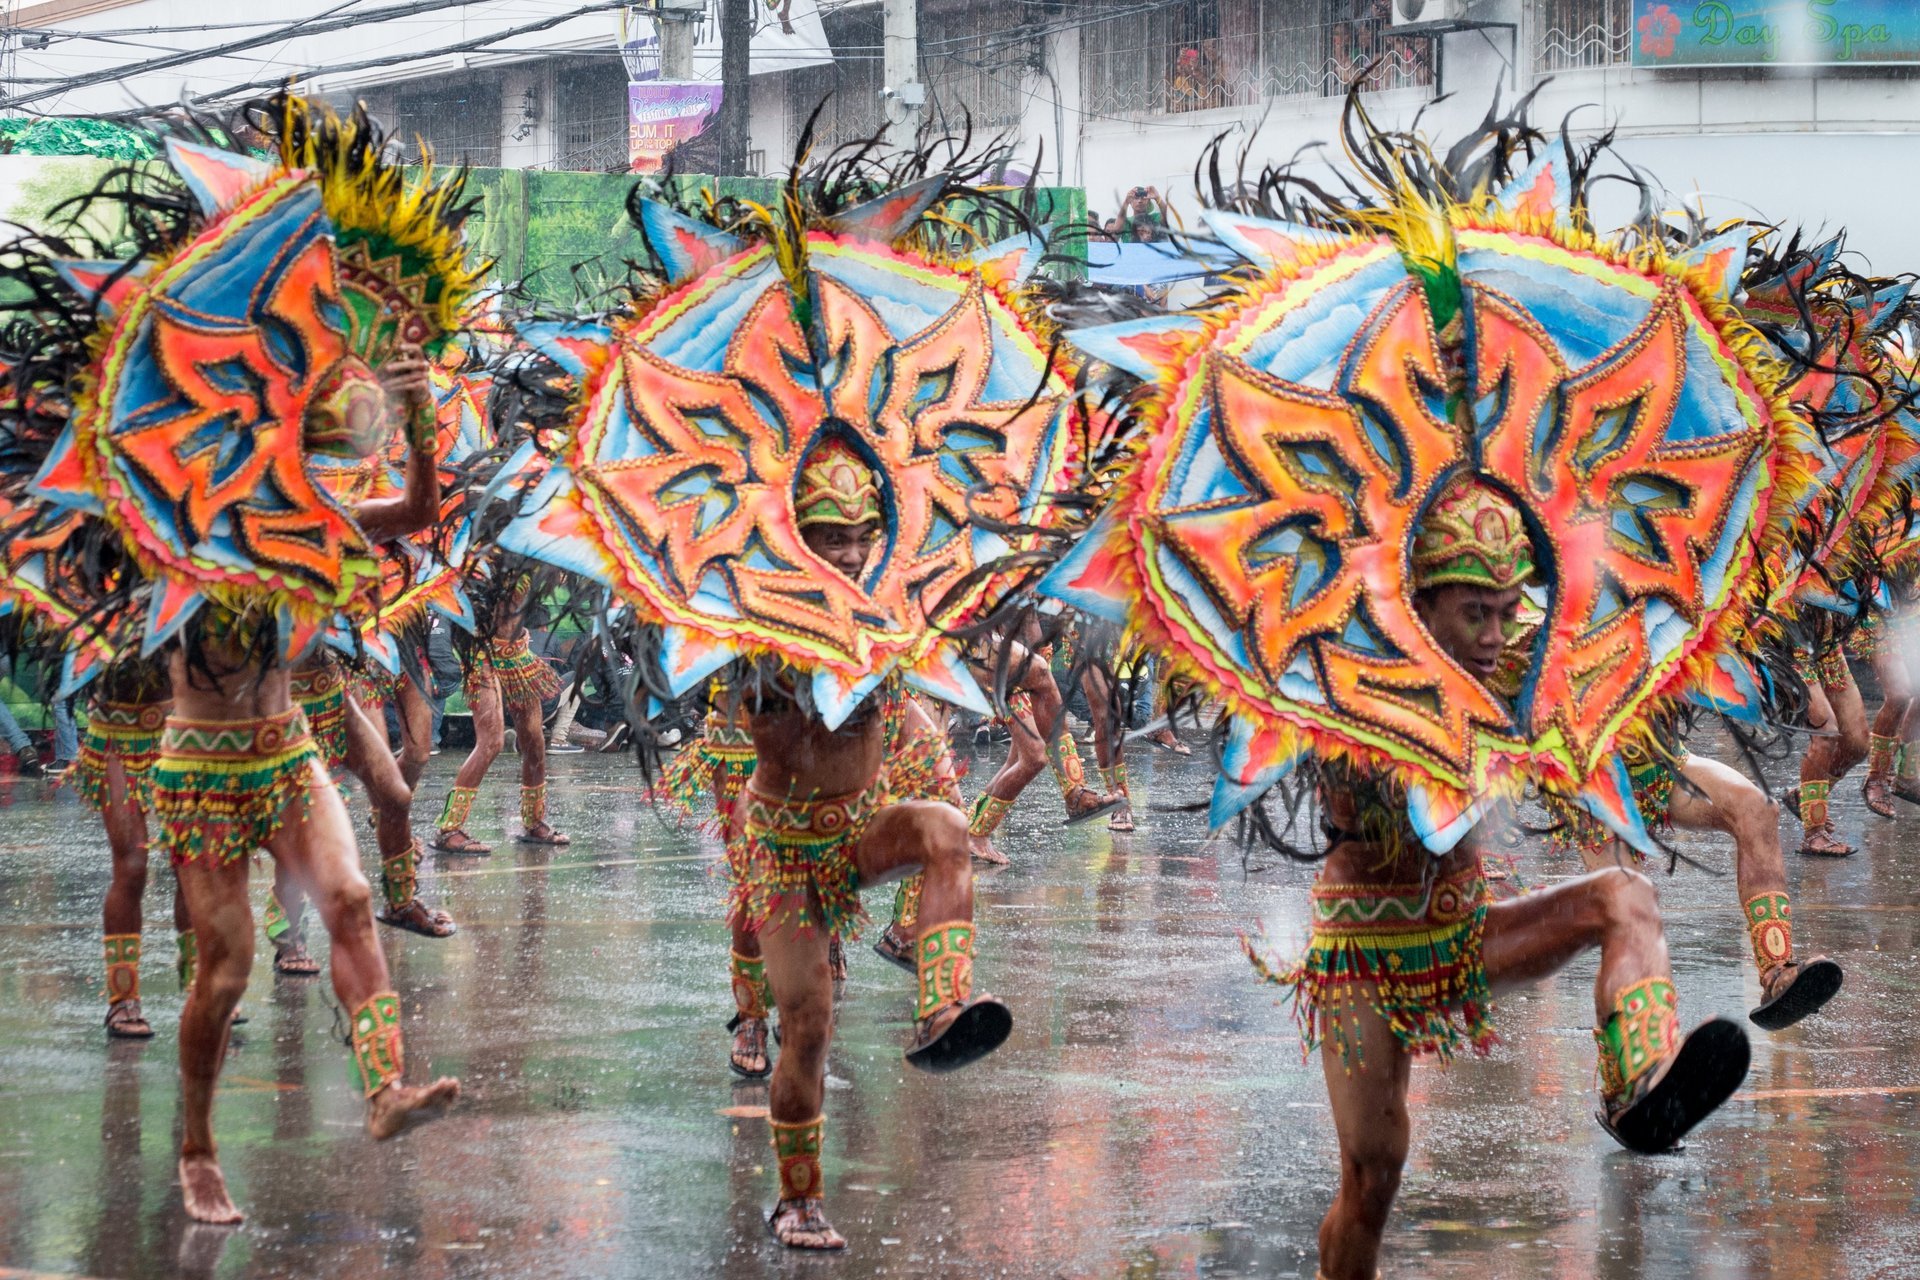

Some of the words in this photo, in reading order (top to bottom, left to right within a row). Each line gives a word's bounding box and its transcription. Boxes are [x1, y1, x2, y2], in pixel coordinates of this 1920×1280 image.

[1693, 0, 1780, 61] Day
[1803, 0, 1891, 60] Spa
[630, 124, 657, 139] SUM
[664, 124, 675, 138] IT
[631, 139, 644, 150] UP
[656, 139, 672, 150] TOP
